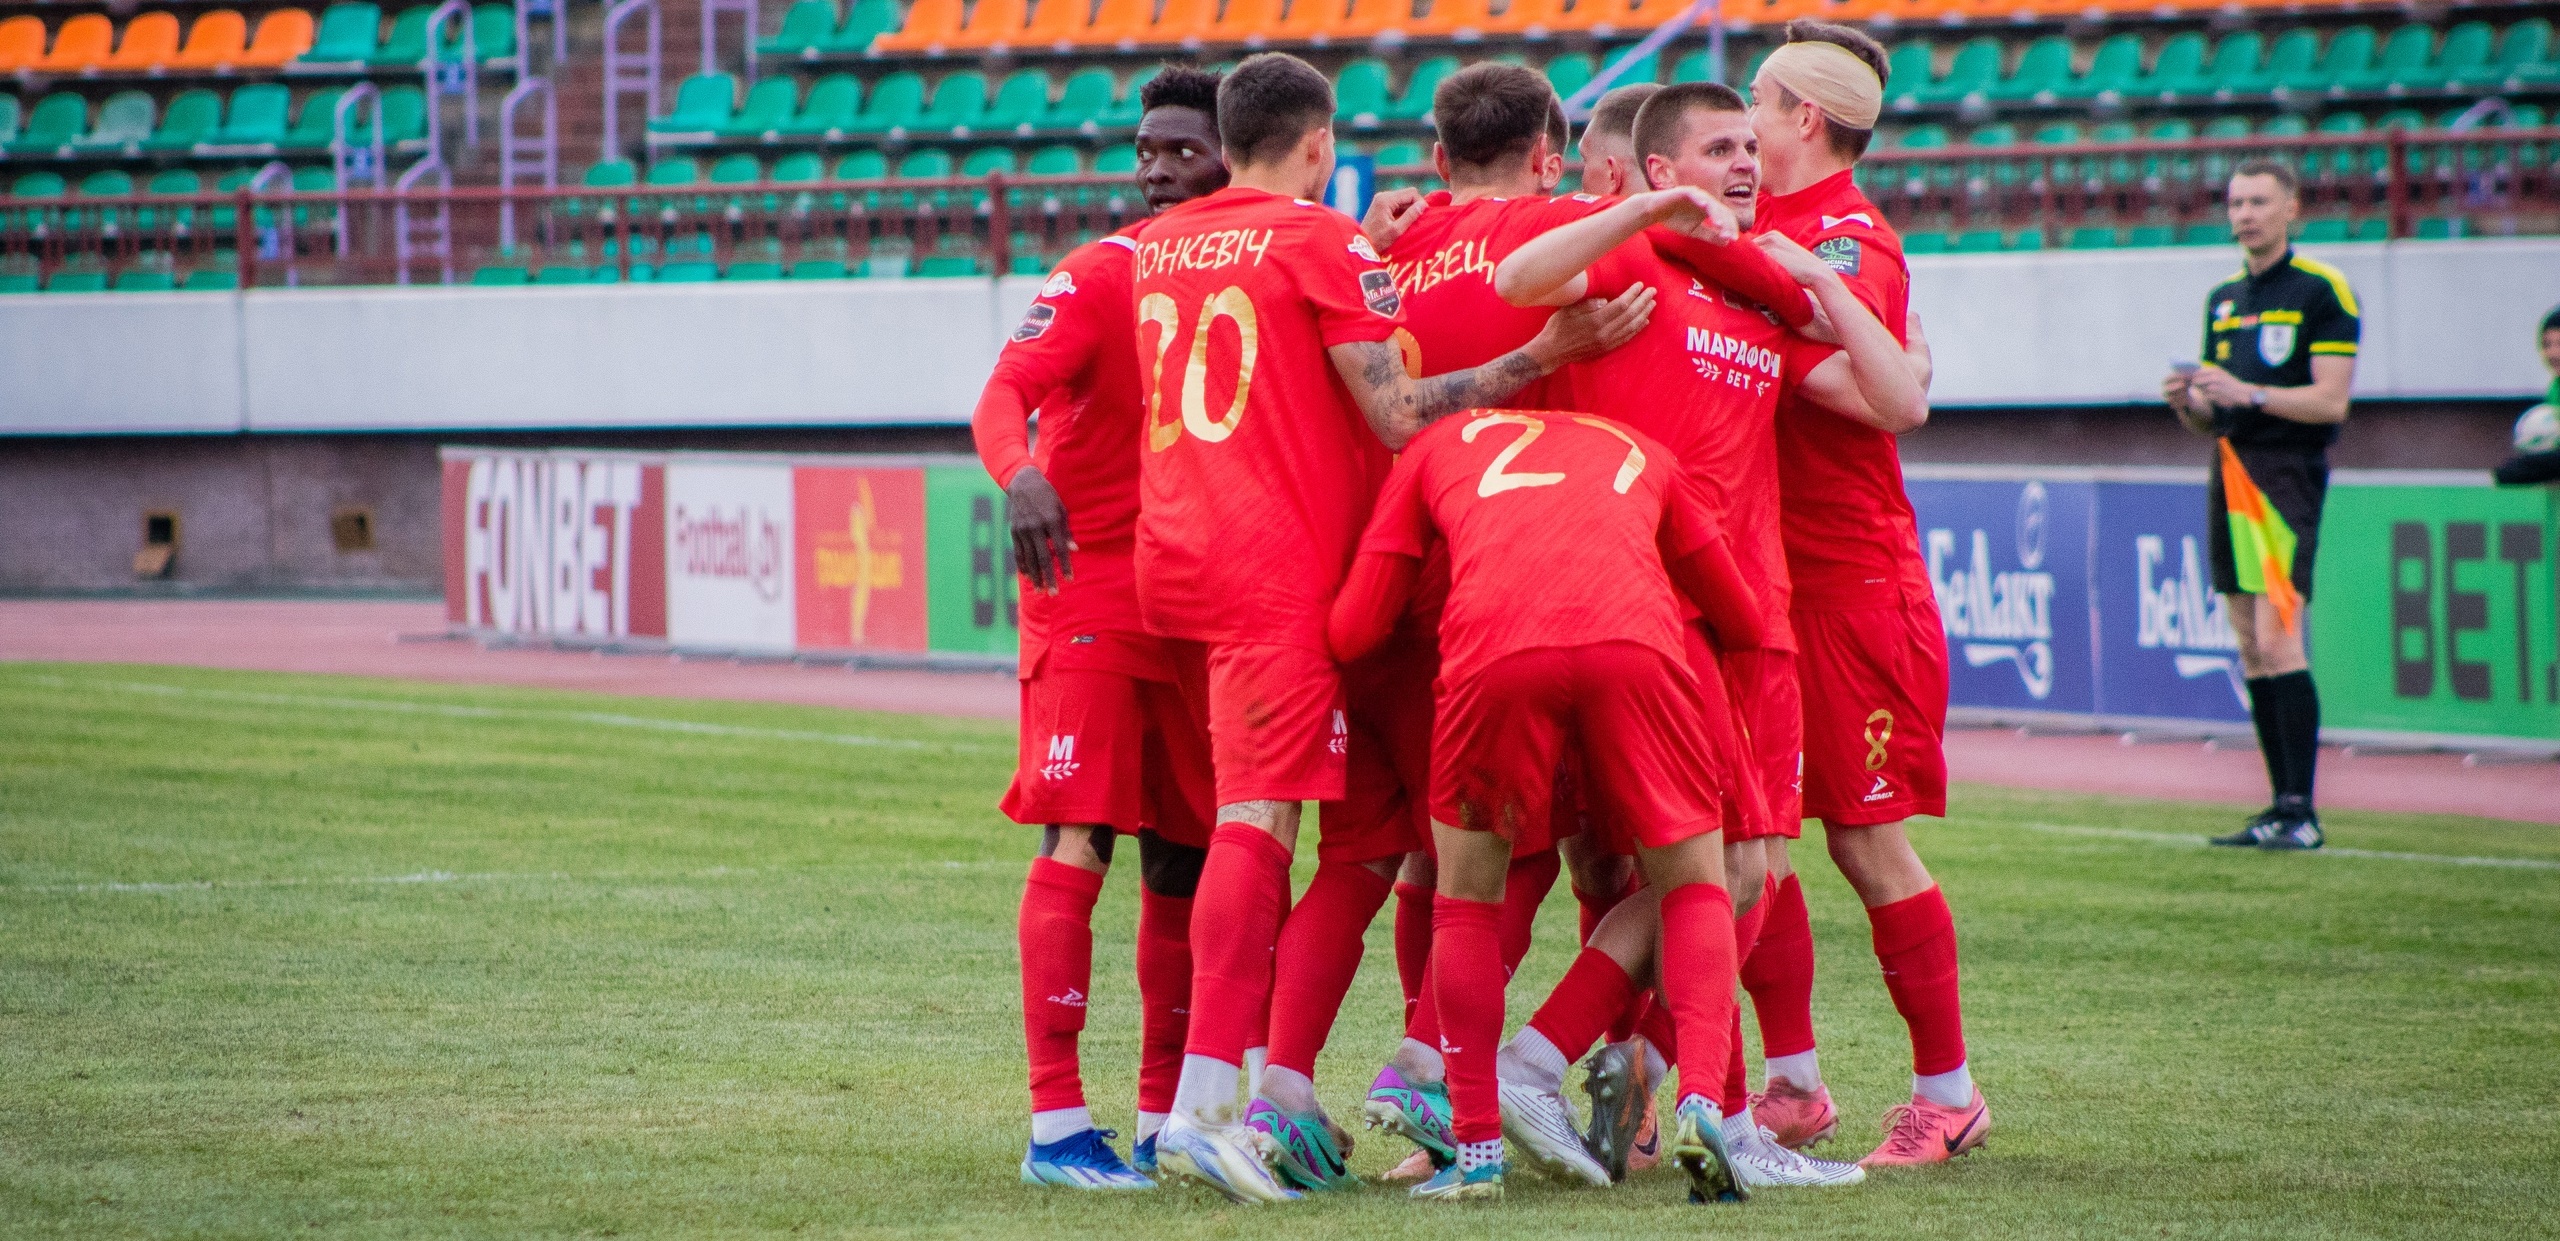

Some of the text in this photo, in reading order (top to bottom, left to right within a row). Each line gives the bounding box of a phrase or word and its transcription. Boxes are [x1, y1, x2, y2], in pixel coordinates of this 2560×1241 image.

[1688, 289, 1713, 303] DEMIX
[1138, 285, 1258, 452] 20
[1726, 368, 1751, 390] БЕТ
[1462, 413, 1646, 498] 27
[465, 460, 642, 636] FONBET
[1864, 709, 1894, 771] 8
[1864, 791, 1894, 802] DEMIX
